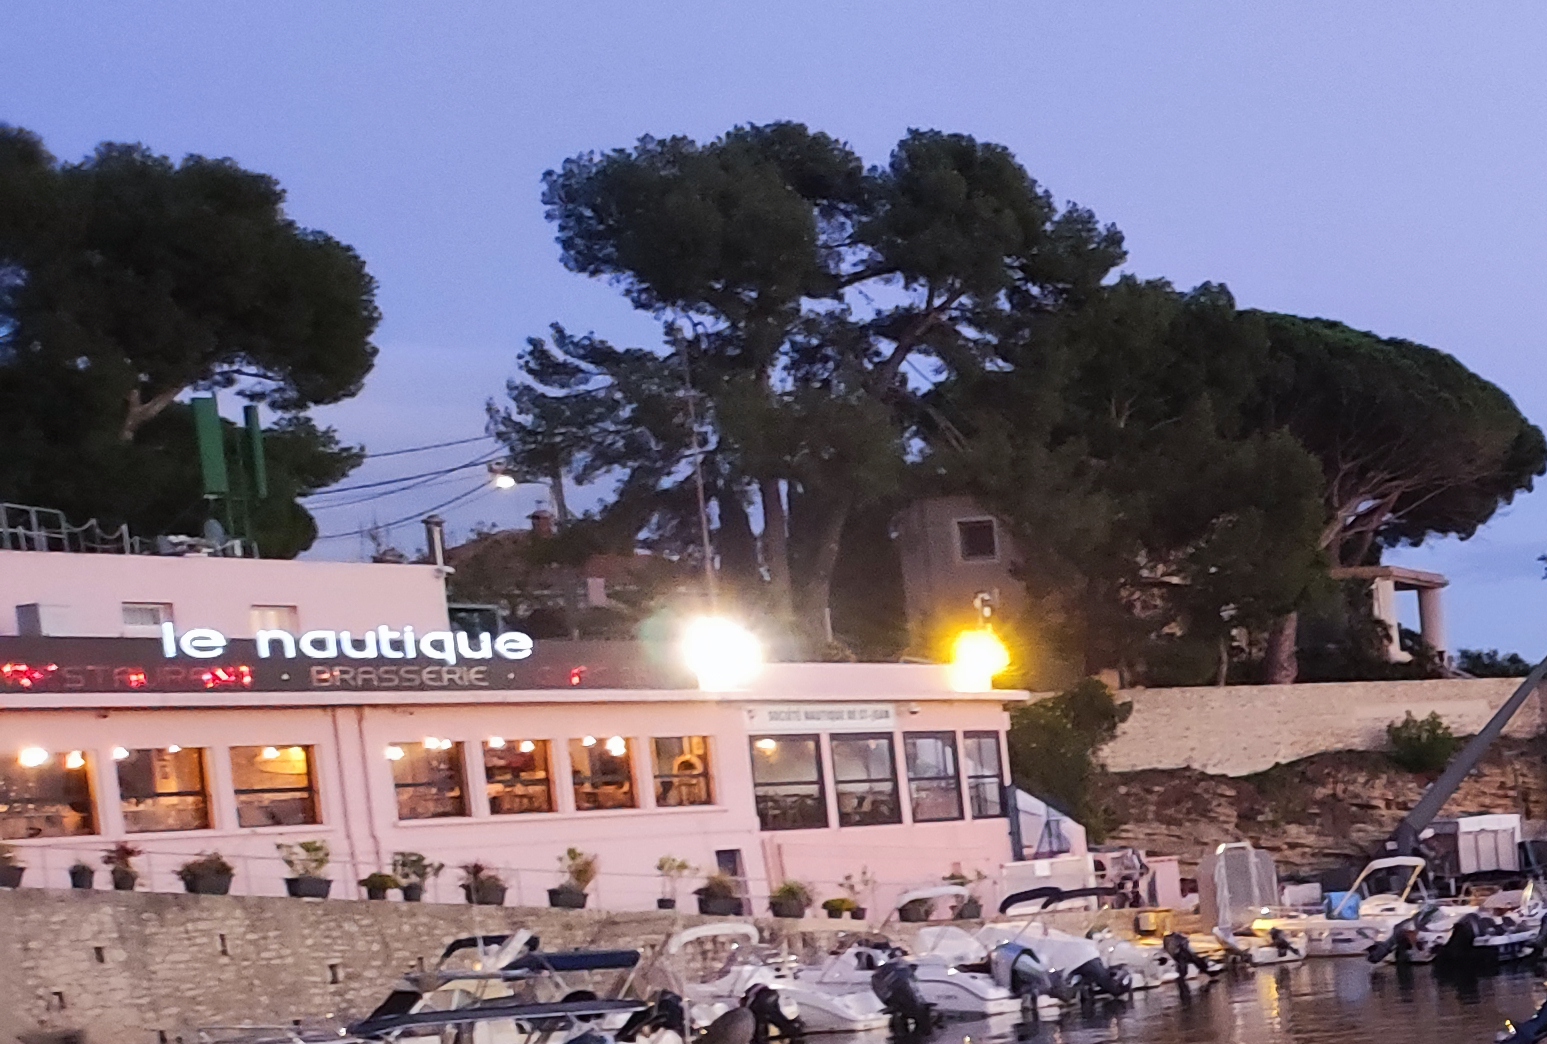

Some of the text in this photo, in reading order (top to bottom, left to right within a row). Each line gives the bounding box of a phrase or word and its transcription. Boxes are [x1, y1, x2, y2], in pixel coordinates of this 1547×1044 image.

[160, 620, 534, 666] le nautique
[309, 665, 490, 688] BRASSERIE
